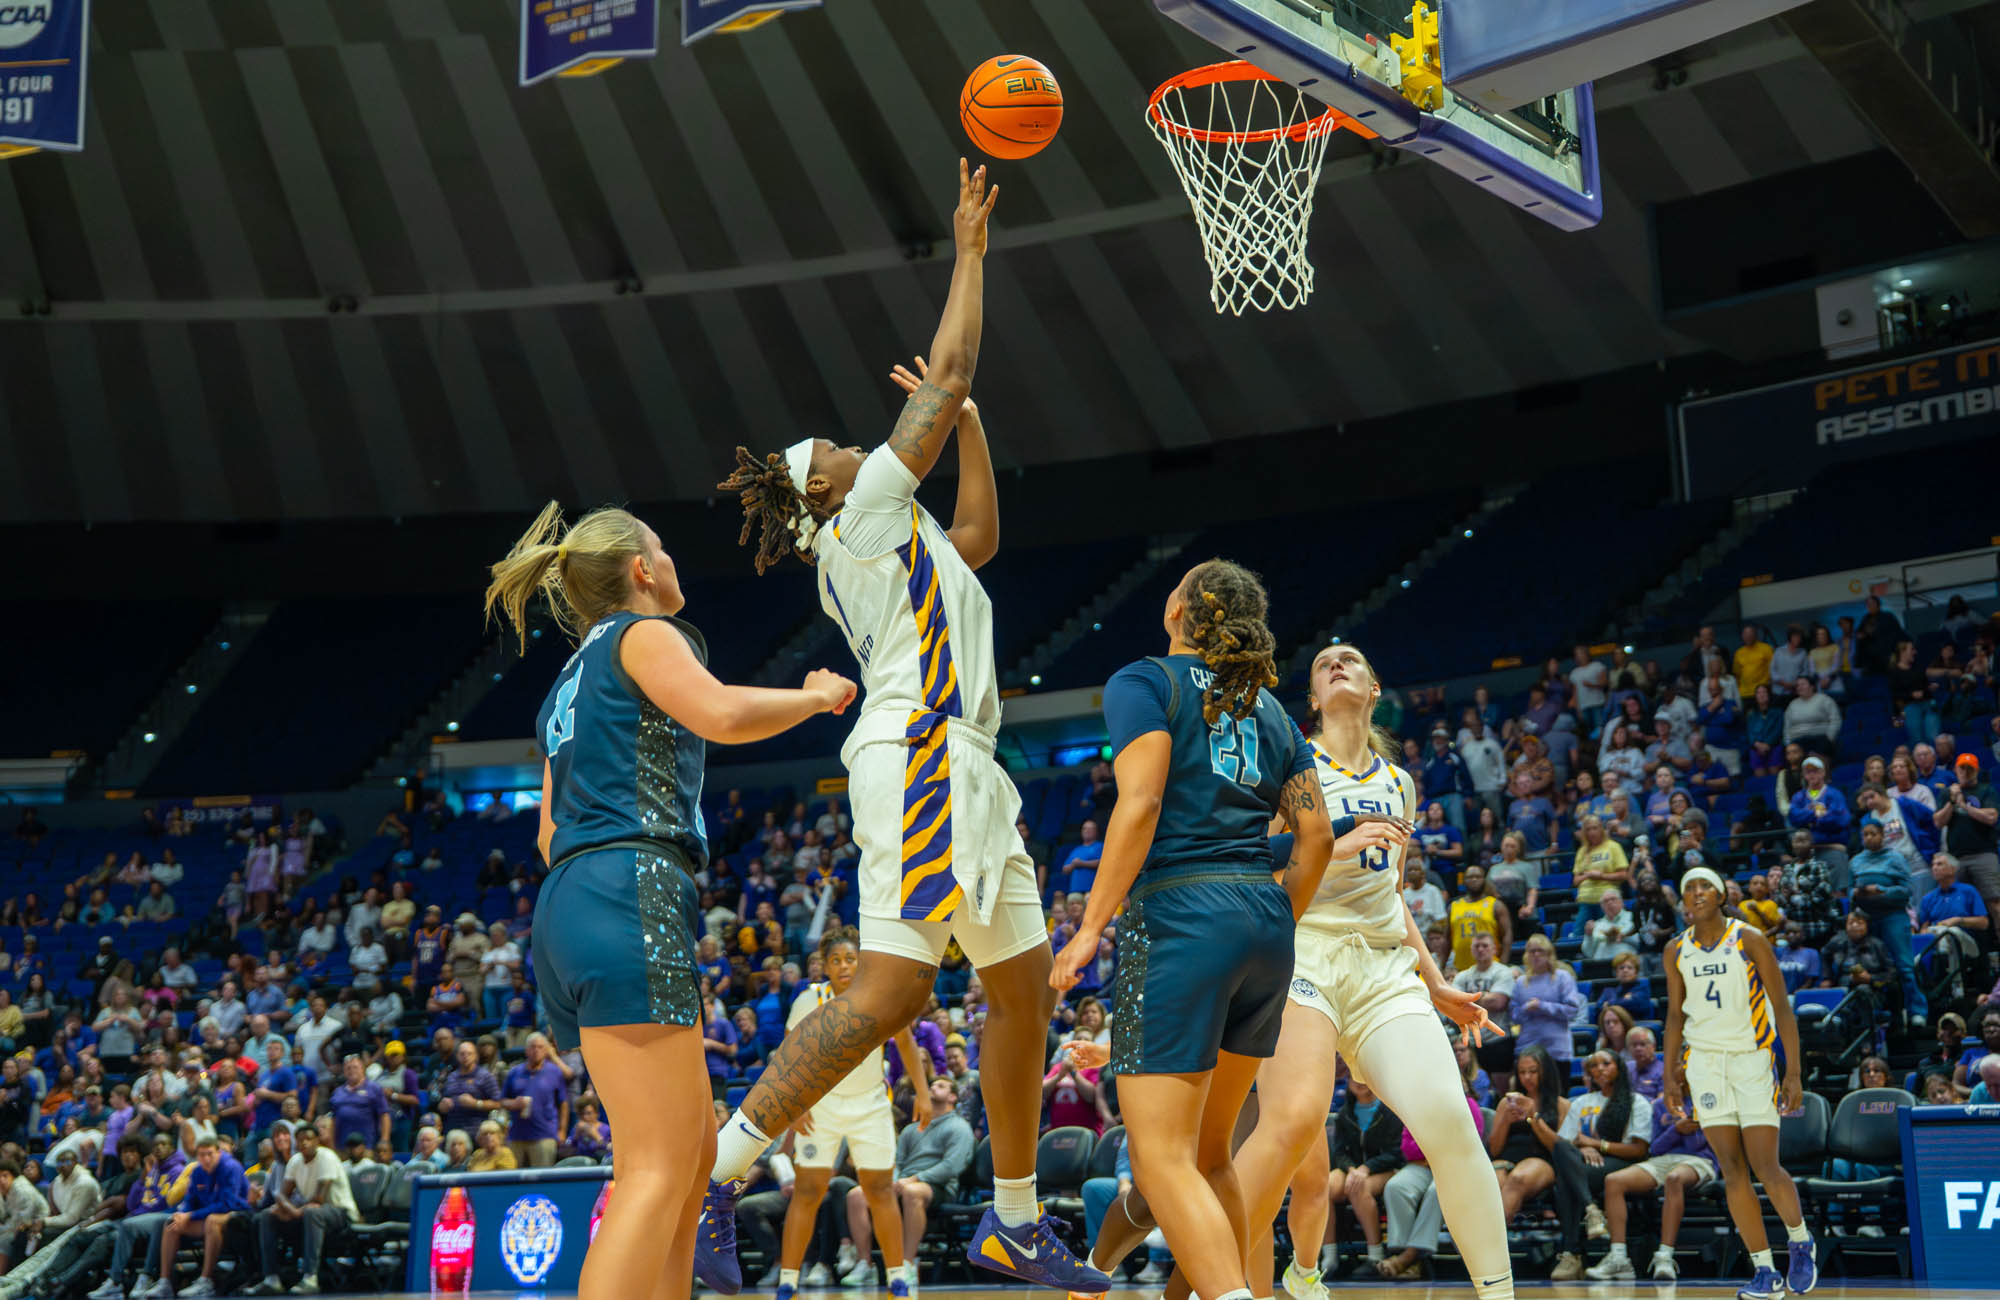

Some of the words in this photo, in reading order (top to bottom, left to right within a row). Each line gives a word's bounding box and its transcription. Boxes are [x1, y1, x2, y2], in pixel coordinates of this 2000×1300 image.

[9, 74, 54, 96] FOUR
[1006, 77, 1057, 95] ELITE
[1813, 359, 1942, 412] PETE
[1208, 711, 1262, 788] 21
[1341, 797, 1392, 817] LSU
[1692, 963, 1727, 978] LSU
[1705, 980, 1722, 1009] 4
[1859, 1102, 1897, 1115] LSU
